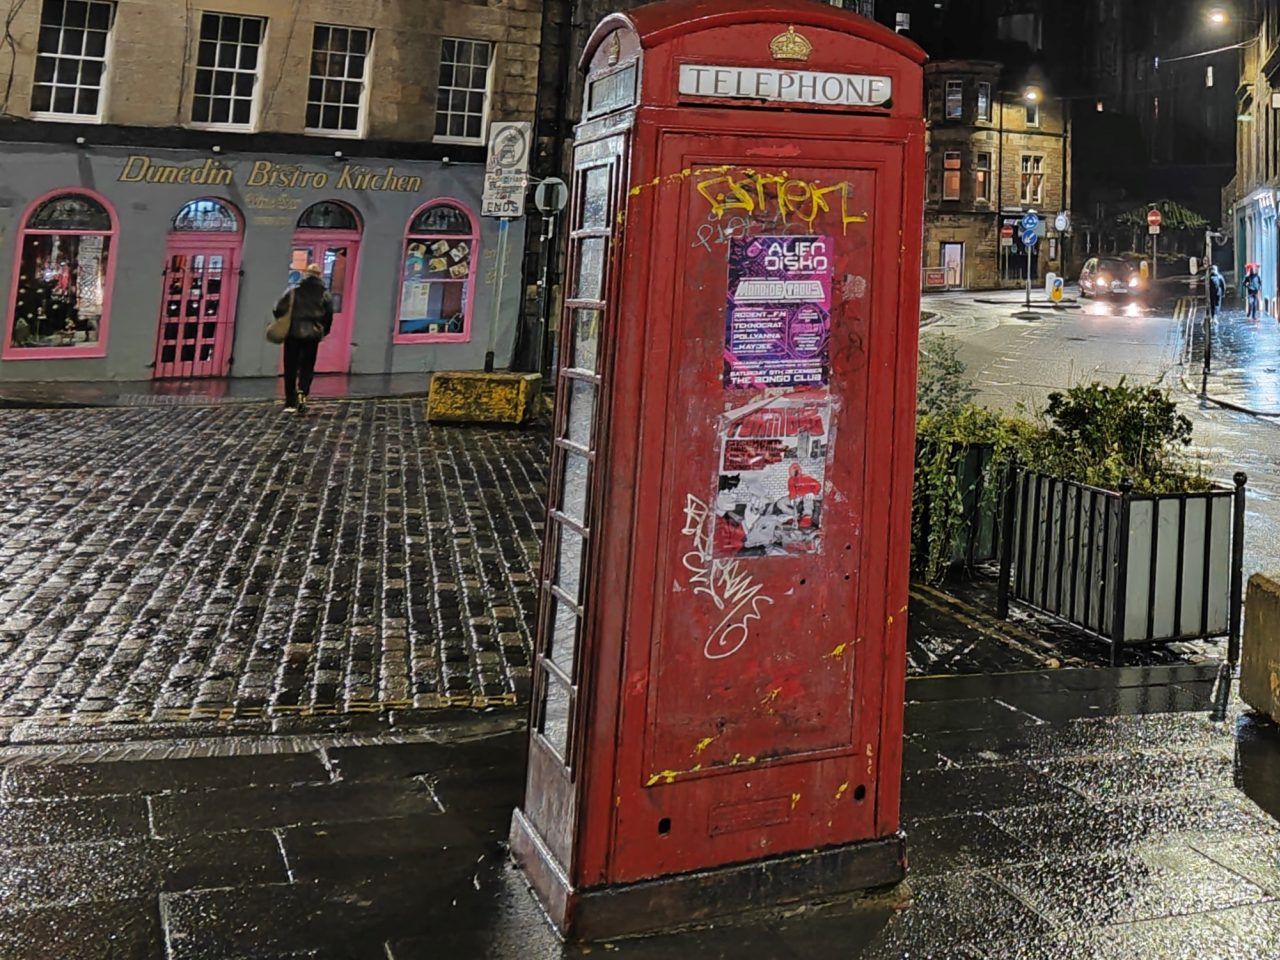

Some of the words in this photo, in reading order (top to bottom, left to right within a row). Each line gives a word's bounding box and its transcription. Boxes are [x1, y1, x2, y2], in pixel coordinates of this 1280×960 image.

[689, 68, 884, 104] TELEPHONE
[118, 155, 233, 186] Dunedin
[247, 160, 329, 189] Bistro
[336, 161, 423, 192] Kitchen
[729, 369, 768, 377] SATURDAY
[730, 376, 752, 385] THE
[754, 375, 791, 383] BONGO
[793, 374, 822, 382] CLUB
